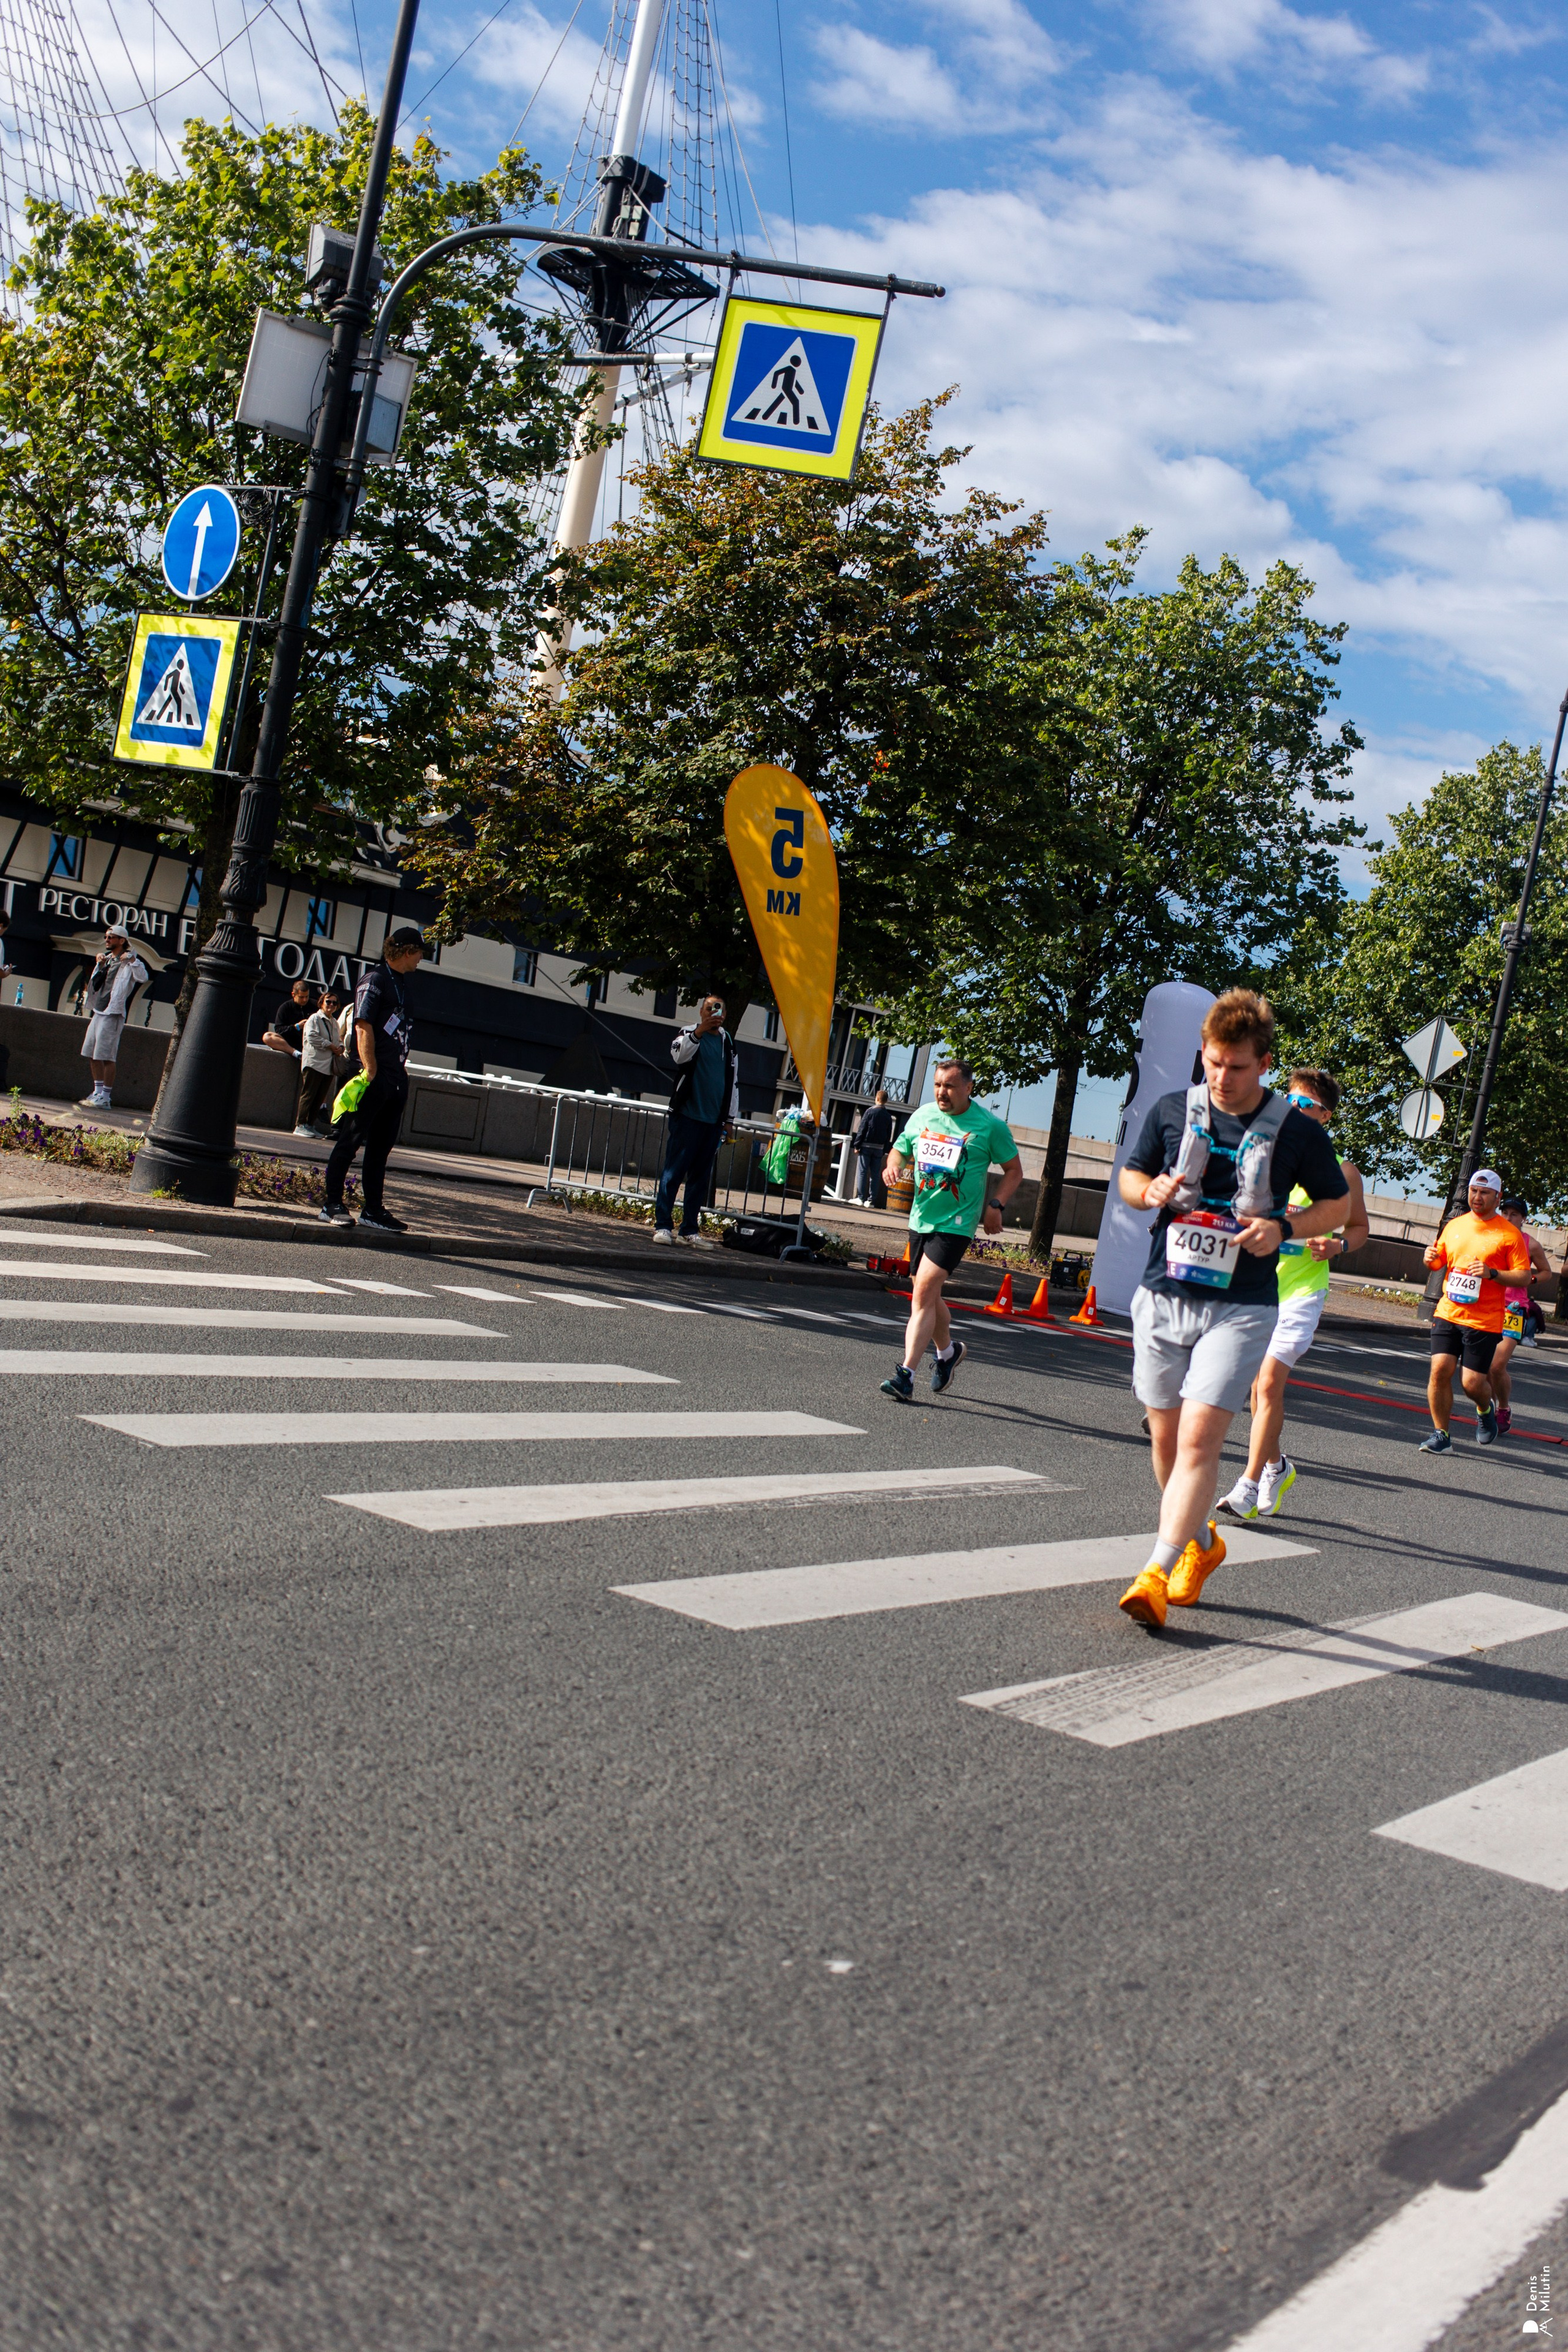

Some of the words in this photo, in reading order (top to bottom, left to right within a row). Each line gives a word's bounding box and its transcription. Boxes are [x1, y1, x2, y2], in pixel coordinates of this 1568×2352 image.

[38, 888, 168, 938] РЕСТОРАН
[922, 1143, 953, 1159] 3541
[1212, 1218, 1224, 1227] 21,1
[1175, 1229, 1228, 1259] 4031
[1188, 1254, 1210, 1262] АРТУР
[1450, 1276, 1476, 1290] 2748
